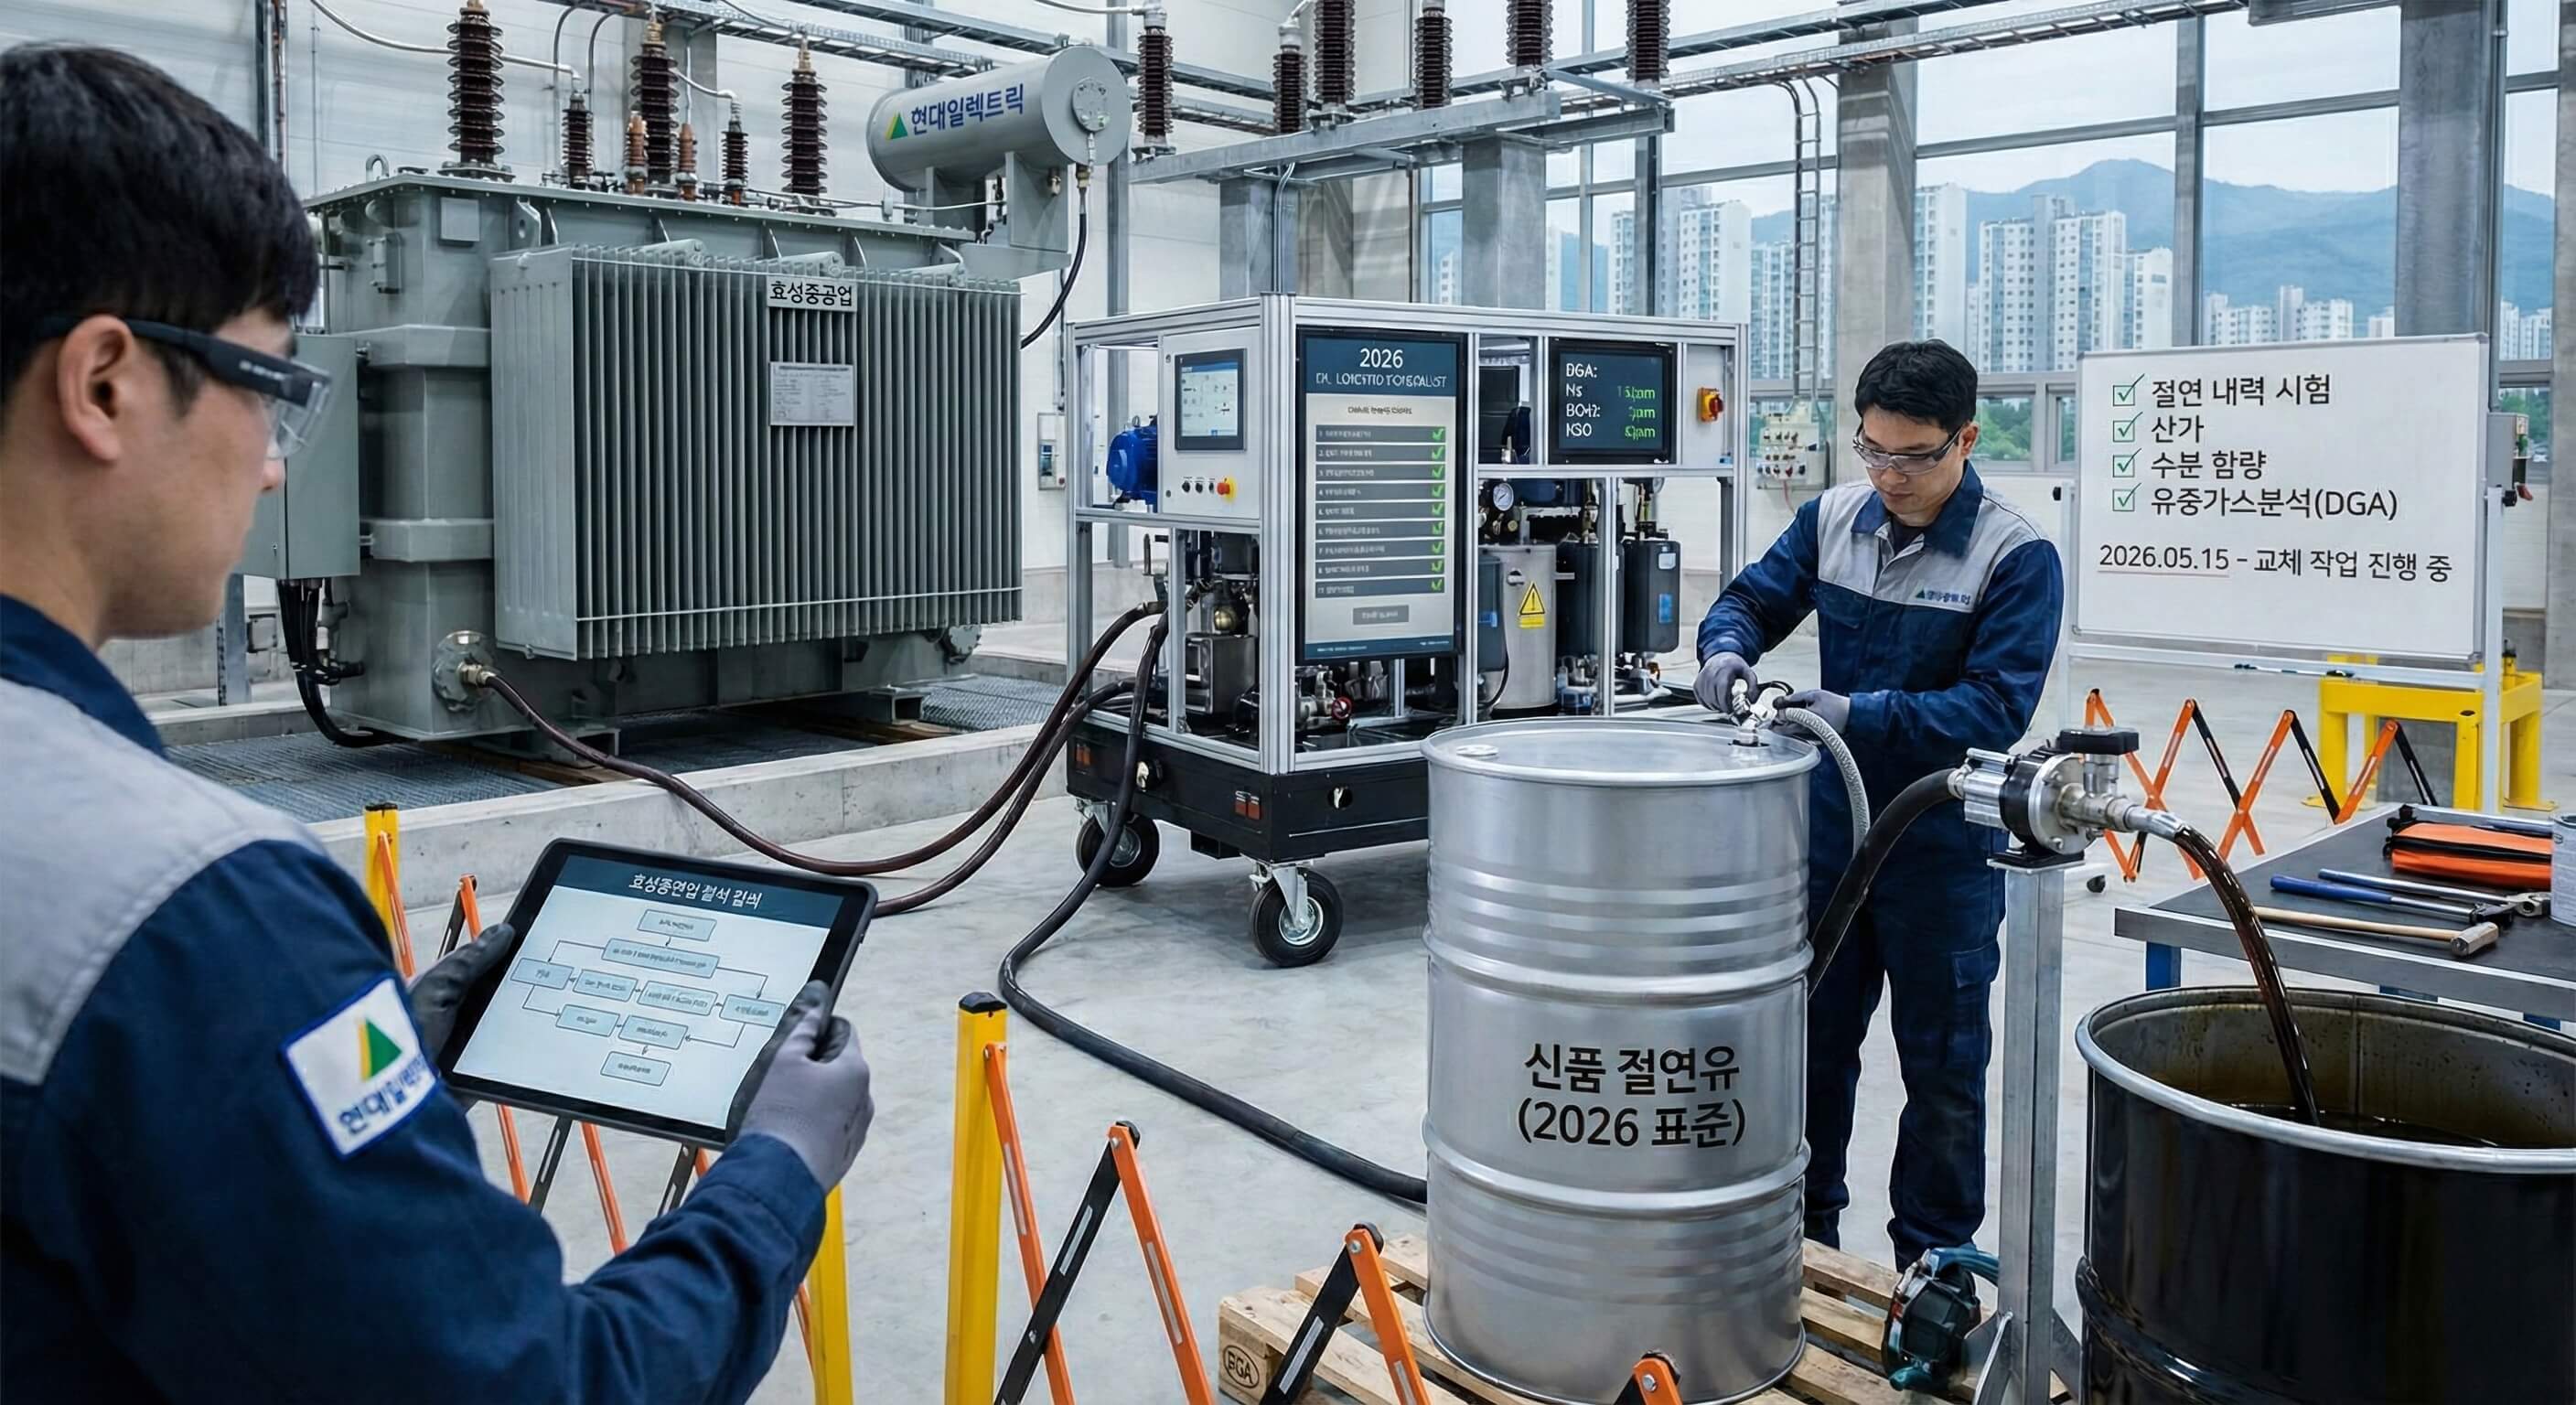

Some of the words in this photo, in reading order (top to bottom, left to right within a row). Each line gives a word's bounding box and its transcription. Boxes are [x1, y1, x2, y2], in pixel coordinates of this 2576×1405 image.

[910, 83, 1024, 135] 현대일렉트릭
[770, 281, 852, 306] 효성중공업
[1359, 348, 1403, 368] 2026
[1566, 363, 1597, 378] DGA:
[2152, 378, 2203, 409] 절연
[2212, 375, 2266, 406] 내력
[2276, 373, 2331, 404] 시험
[2152, 414, 2204, 443] 산가
[2152, 452, 2203, 479] 수분
[2212, 449, 2267, 480] 함량
[2152, 487, 2398, 520] 유중가스분석(DGA)
[2099, 544, 2228, 570] 2026.05.15
[2253, 548, 2302, 576] 교체
[2310, 549, 2358, 579] 작업
[2367, 552, 2417, 582] 진행
[2426, 554, 2453, 582] 중
[1525, 1044, 1606, 1094] 신품
[1617, 1046, 1740, 1096] 절연유
[1519, 1098, 1639, 1147] (2026
[1651, 1098, 1746, 1148] 표준)
